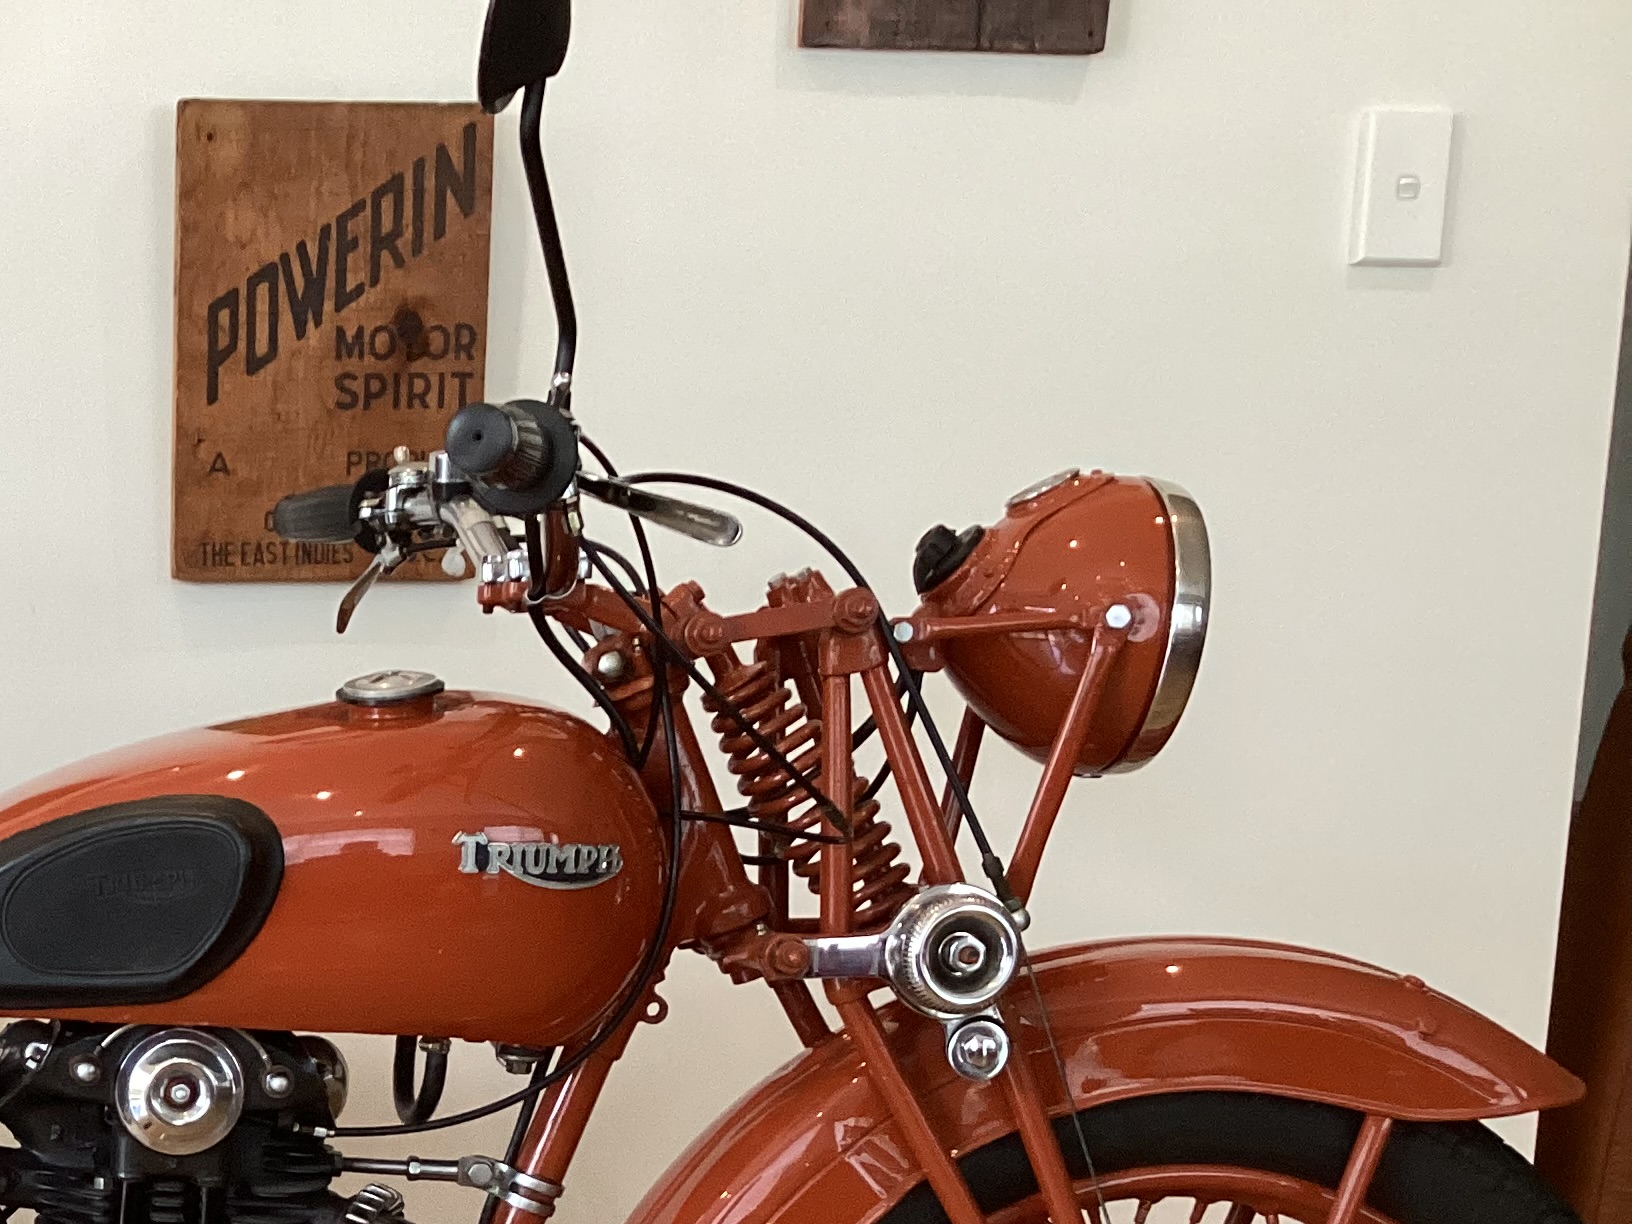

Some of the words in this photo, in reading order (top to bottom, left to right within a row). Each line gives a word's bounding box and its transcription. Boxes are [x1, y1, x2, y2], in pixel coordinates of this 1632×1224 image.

[206, 121, 477, 406] POWERIN
[334, 322, 477, 362] MOOR
[334, 373, 476, 411] SPIRIT
[208, 452, 231, 477] A
[201, 541, 236, 568] THE
[240, 540, 291, 567] EAST
[451, 830, 624, 890] TRIUMPH
